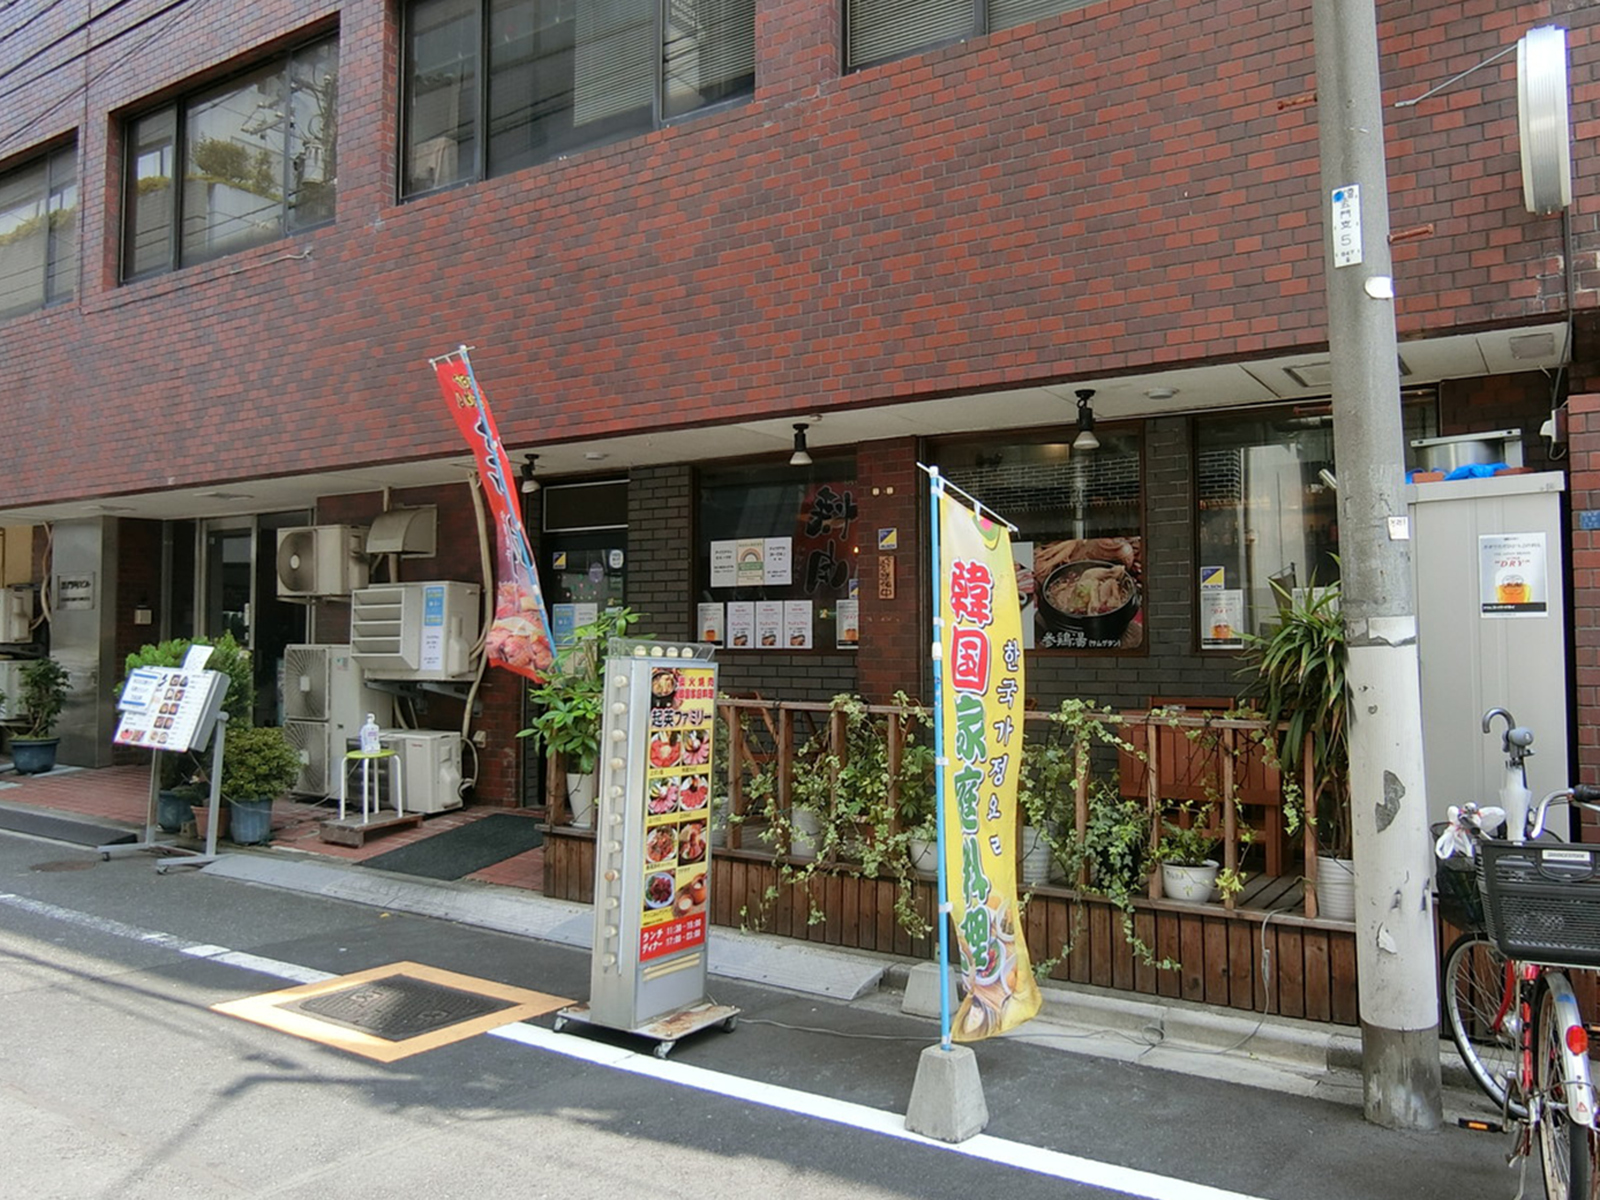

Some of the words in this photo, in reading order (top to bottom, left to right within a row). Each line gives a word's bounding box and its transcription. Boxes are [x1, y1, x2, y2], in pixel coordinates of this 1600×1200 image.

[1041, 631, 1088, 648] 参鶏湯
[642, 928, 663, 943] ランチ
[642, 941, 663, 954] ディナー
